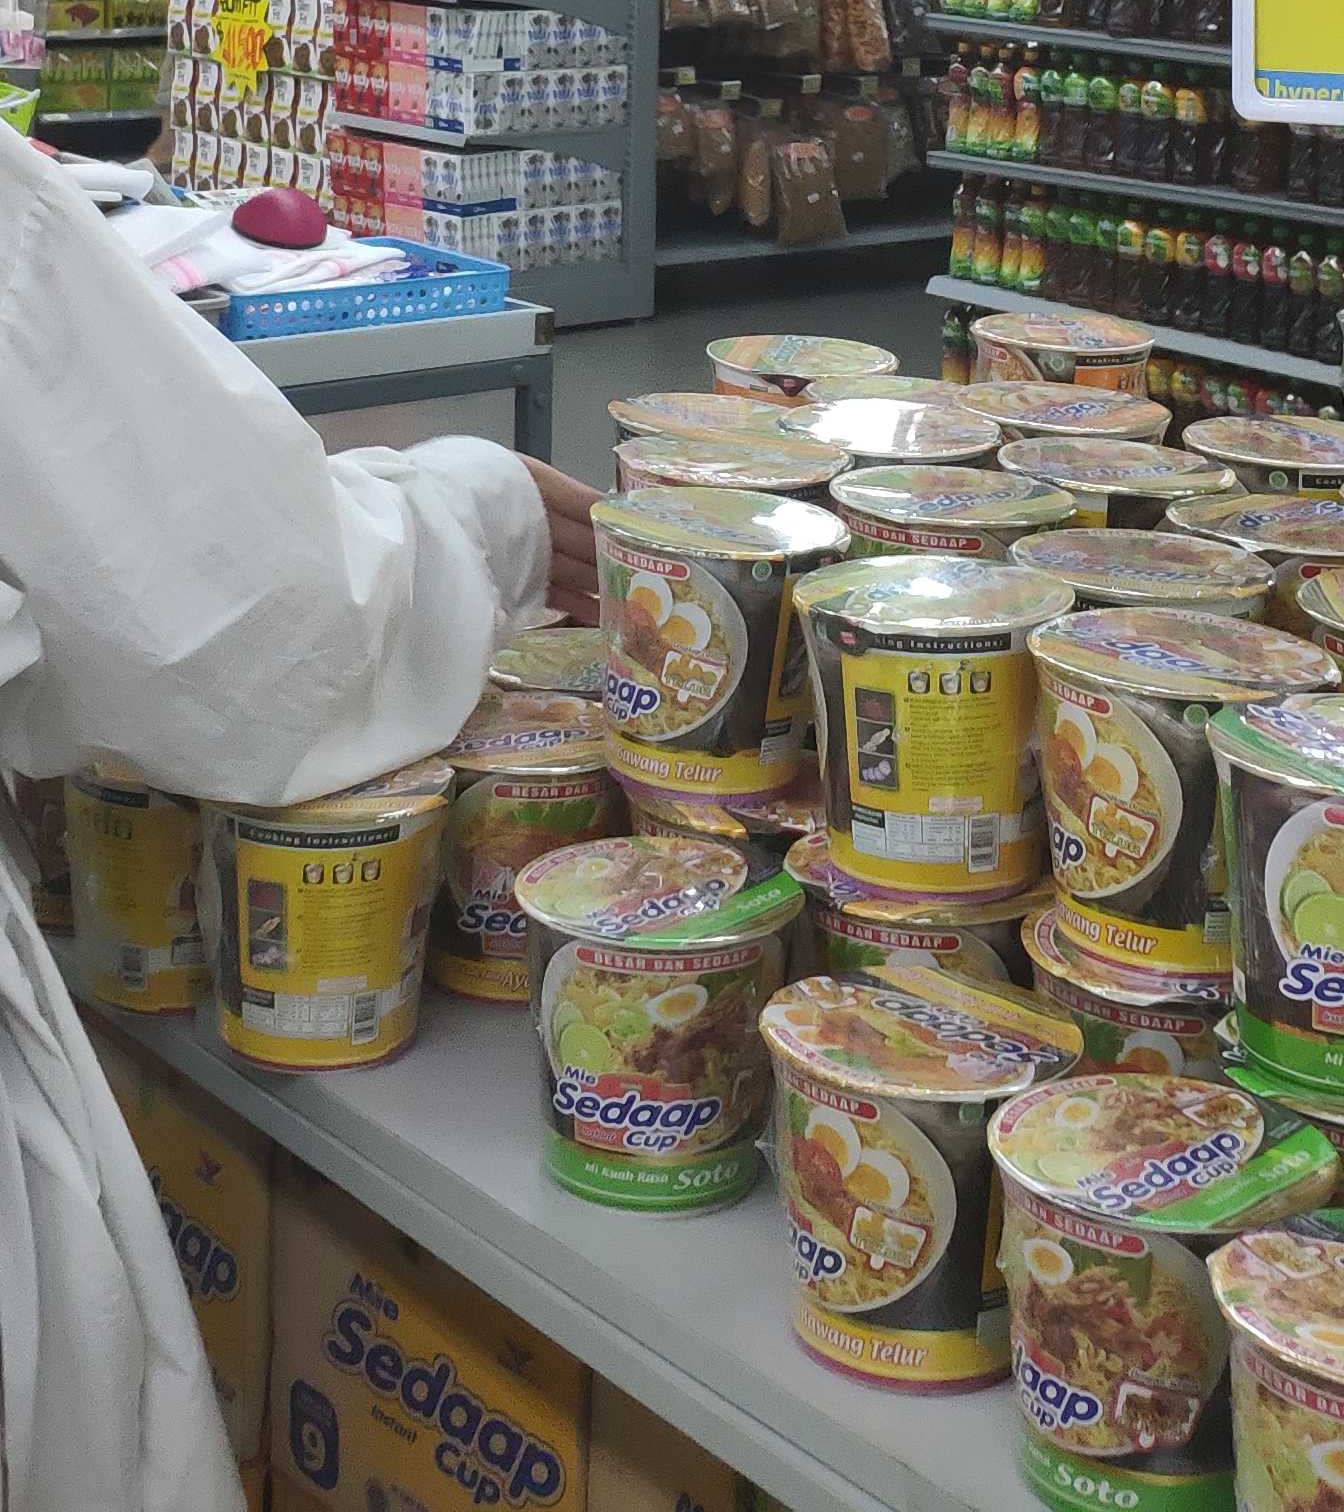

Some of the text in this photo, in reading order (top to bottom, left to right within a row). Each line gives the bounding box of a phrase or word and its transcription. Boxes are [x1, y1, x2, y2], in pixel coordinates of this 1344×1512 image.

[882, 527, 968, 549] DAN SEDAAP
[626, 552, 674, 574] SEDAAP
[608, 674, 658, 717] aap
[675, 760, 722, 783] Telur
[879, 930, 942, 949] SEDAAP
[1058, 904, 1158, 954] wang Telur
[594, 949, 750, 972] BESAR DAN SEDAAP
[1300, 943, 1344, 964] Mie
[1118, 1010, 1186, 1032] SEDAAP
[554, 1081, 722, 1136] Sedaap
[802, 1082, 861, 1114] SEDAAP
[624, 1130, 679, 1152] Cup
[672, 1159, 740, 1190] Soto
[1091, 1130, 1244, 1211] Sedaap
[1190, 1160, 1236, 1187] Cup
[1258, 1149, 1311, 1180] Soto
[1053, 1213, 1125, 1250] SEDAAP
[787, 1223, 844, 1277] aap
[869, 1338, 929, 1367] Telur
[1016, 1341, 1100, 1425] aap
[1259, 1363, 1307, 1402] BESAR
[326, 1305, 563, 1500] Sedaap
[434, 1441, 500, 1505] Cup
[1054, 1463, 1140, 1509] Soto
